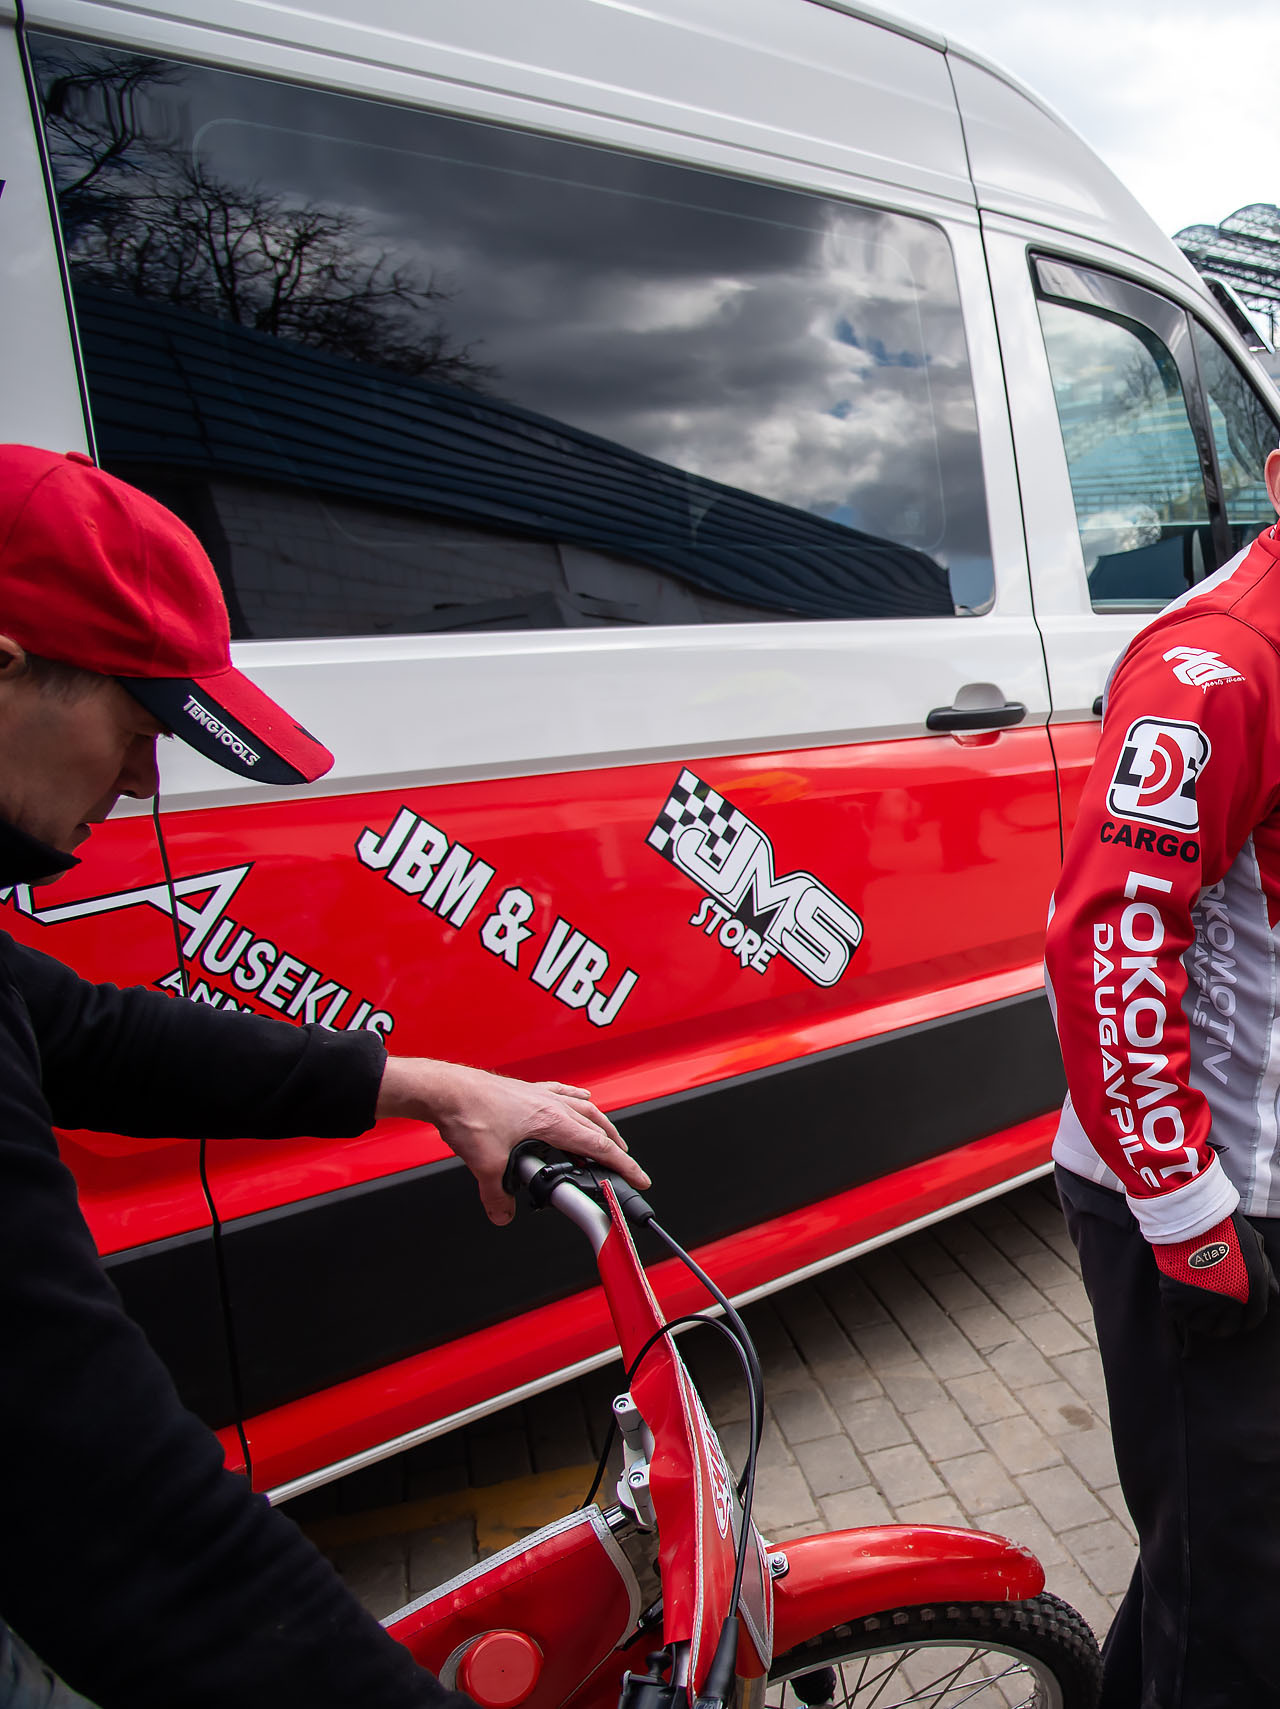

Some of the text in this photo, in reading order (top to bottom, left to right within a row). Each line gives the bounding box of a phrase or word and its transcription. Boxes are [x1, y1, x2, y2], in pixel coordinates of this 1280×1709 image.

[1100, 821, 1200, 863] CARGO
[354, 804, 639, 1027] JBM & VBJ
[688, 896, 779, 975] STORE
[1119, 871, 1201, 1181] LOKOMOT
[1195, 1245, 1226, 1265] Atlas
